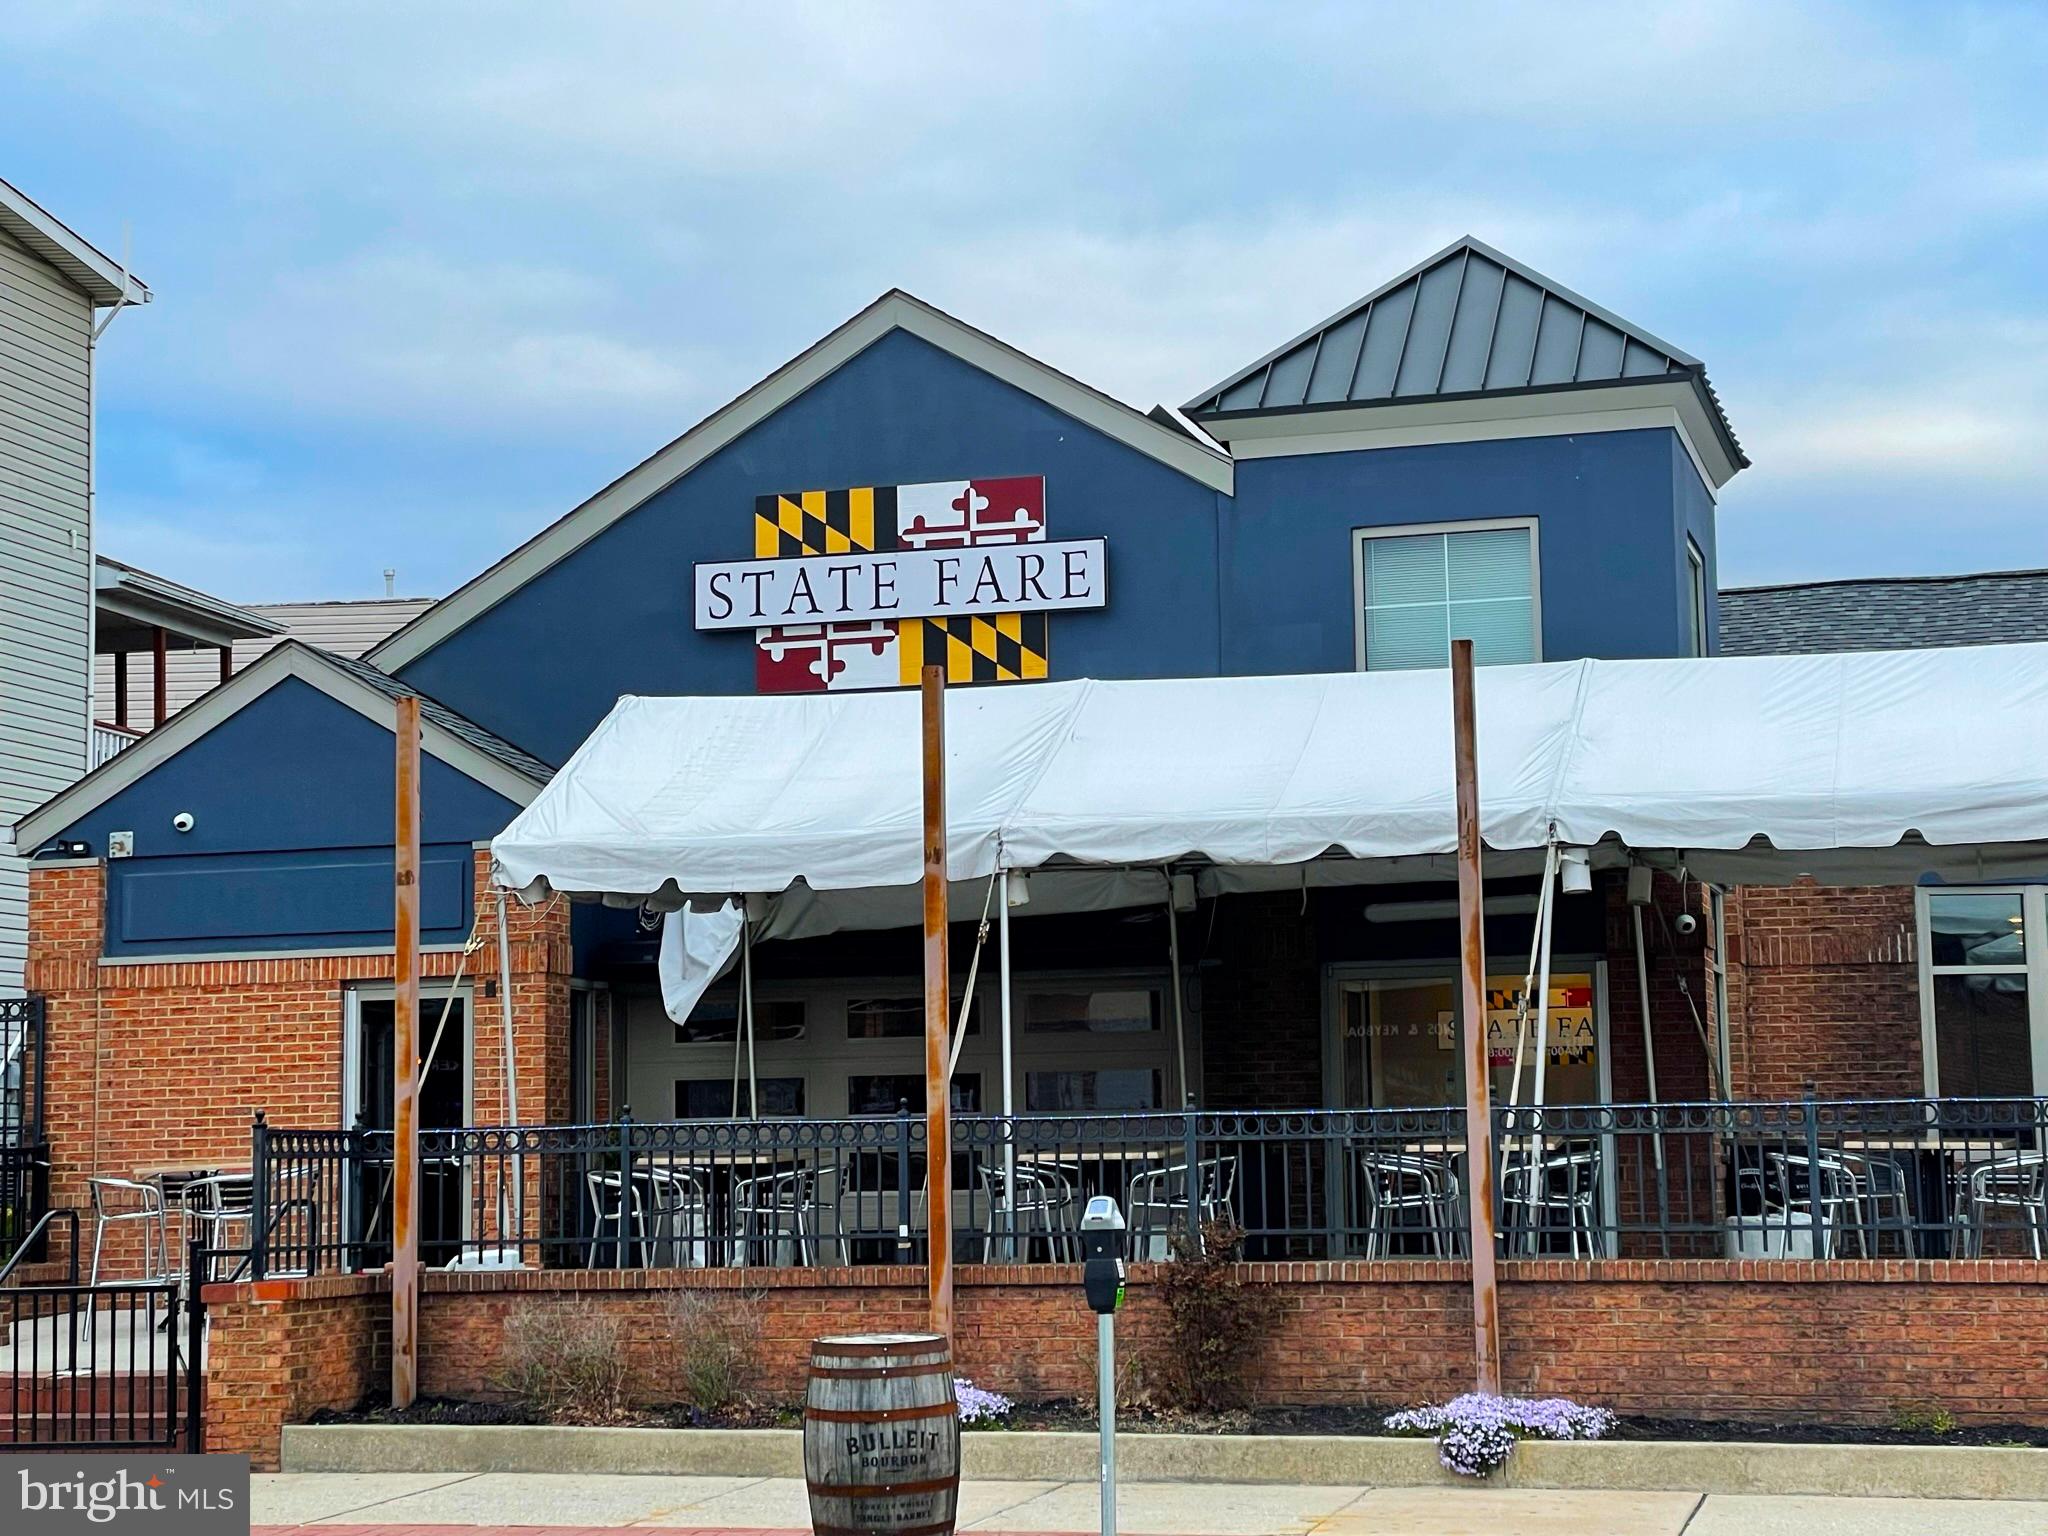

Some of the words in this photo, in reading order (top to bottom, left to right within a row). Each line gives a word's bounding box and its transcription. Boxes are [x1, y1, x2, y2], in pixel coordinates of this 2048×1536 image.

[708, 561, 900, 620] STATE
[932, 550, 1091, 606] FARE
[845, 1430, 940, 1455] BULLEIT
[861, 1454, 927, 1468] BOURBON
[896, 1510, 932, 1522] BARREL
